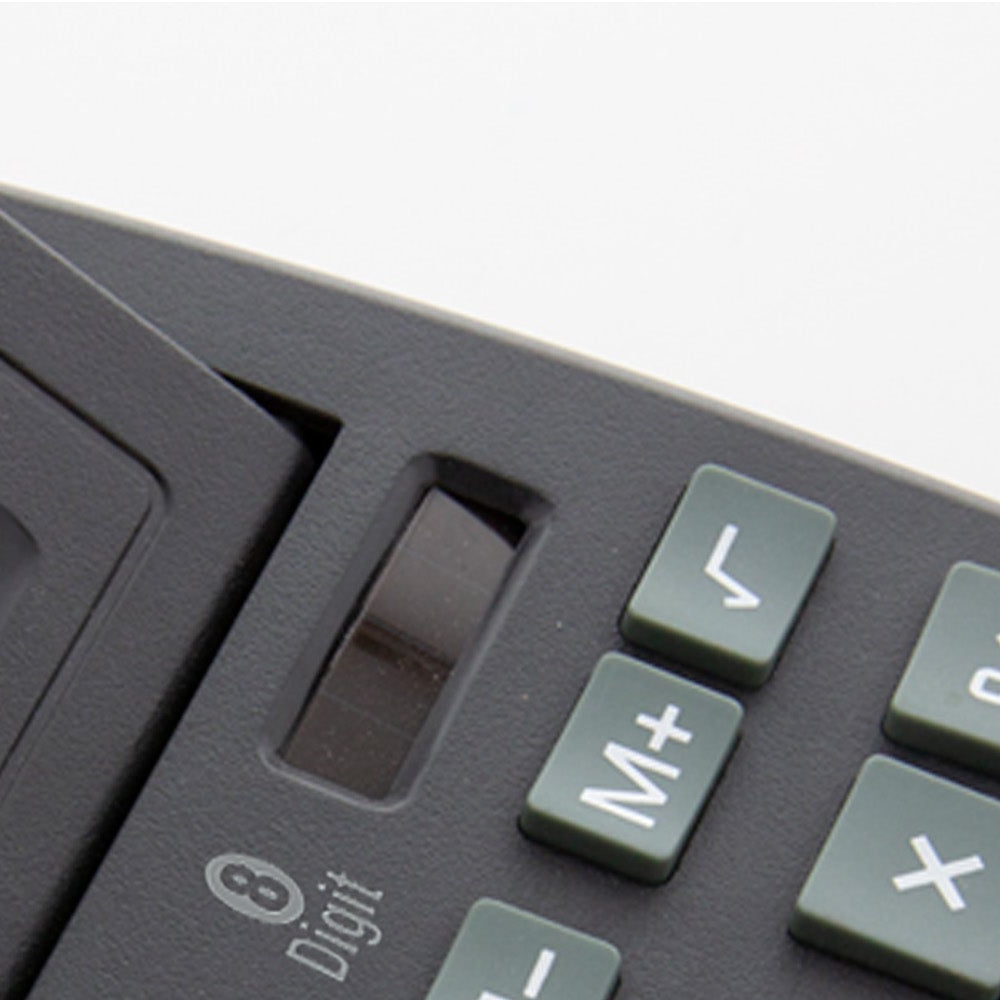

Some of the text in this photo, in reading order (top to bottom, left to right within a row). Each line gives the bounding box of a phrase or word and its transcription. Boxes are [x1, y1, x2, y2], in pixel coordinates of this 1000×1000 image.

[579, 704, 693, 829] M+
[218, 862, 291, 912] 8
[285, 870, 384, 982] Digit
